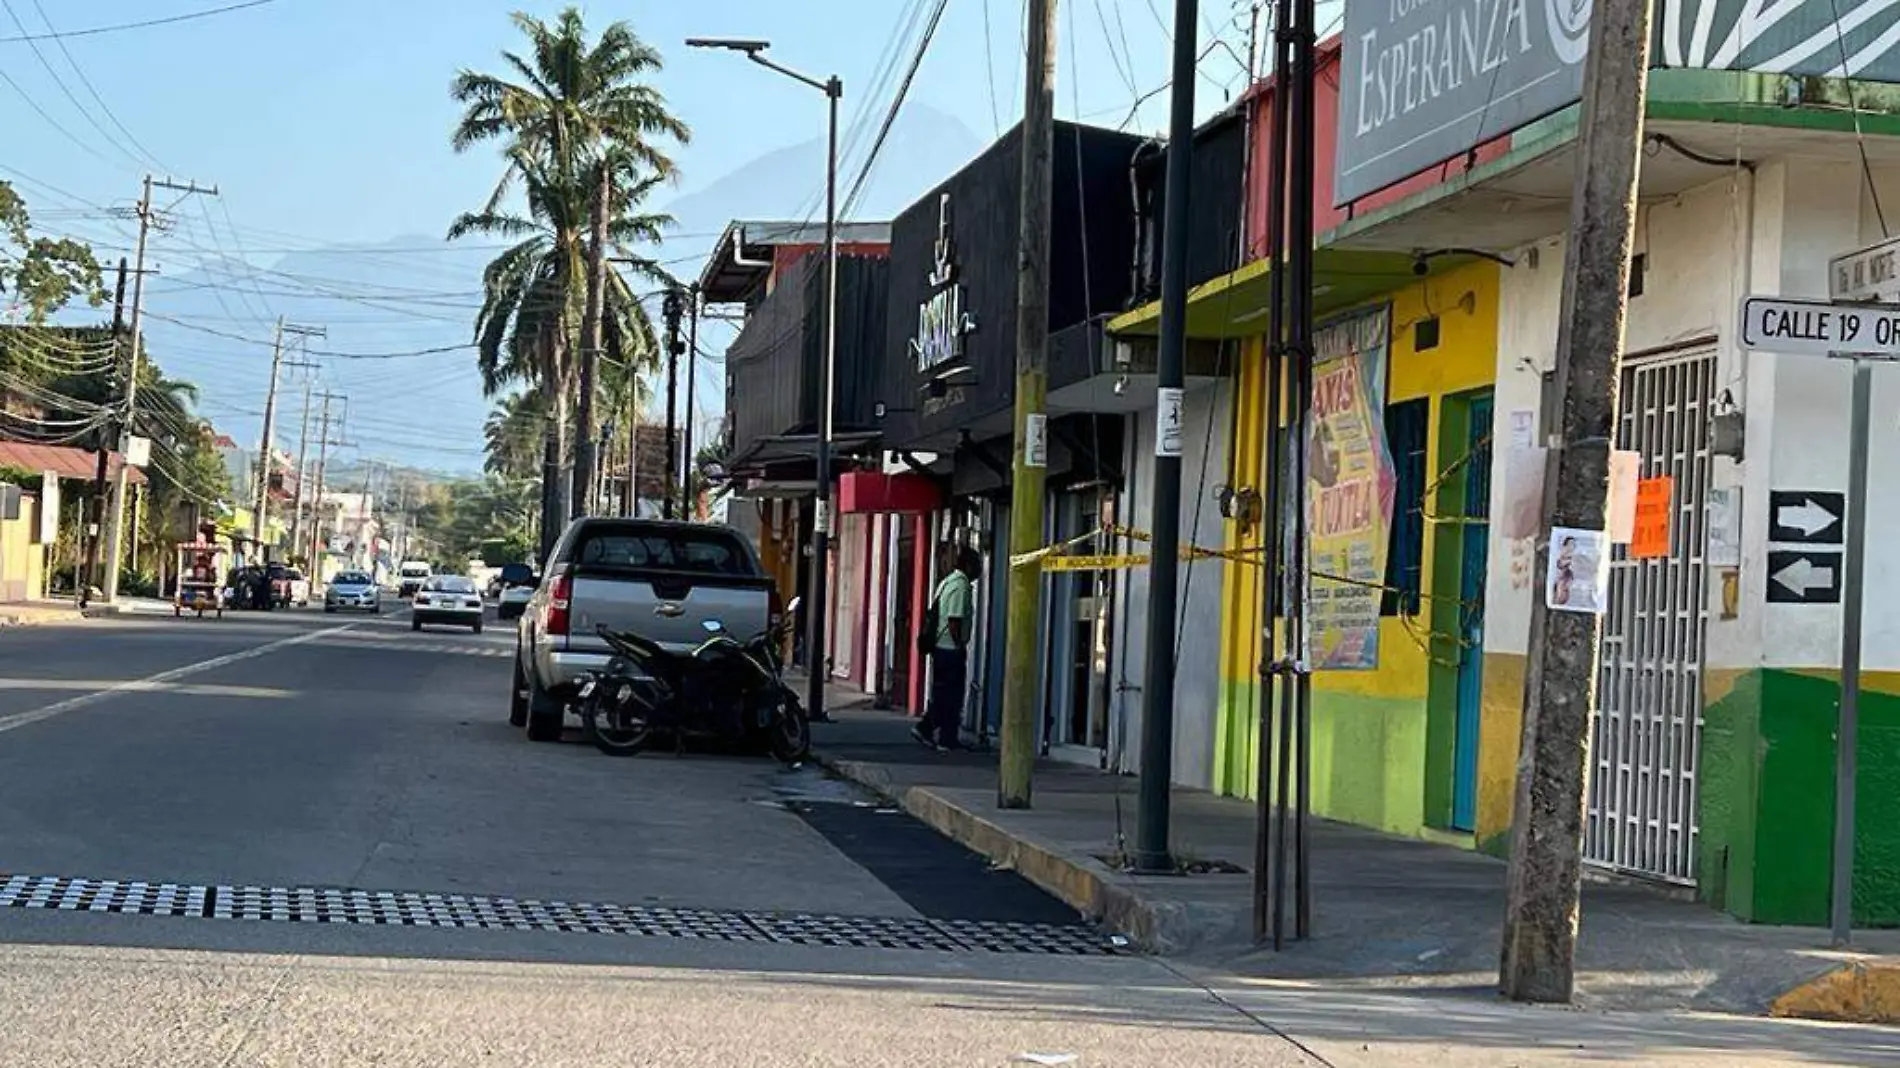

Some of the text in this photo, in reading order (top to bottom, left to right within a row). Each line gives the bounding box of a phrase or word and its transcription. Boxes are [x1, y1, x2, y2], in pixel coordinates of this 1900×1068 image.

[1356, 0, 1532, 137] ESPERANZA
[1762, 309, 1830, 340] CALLE
[1838, 314, 1860, 341] 19
